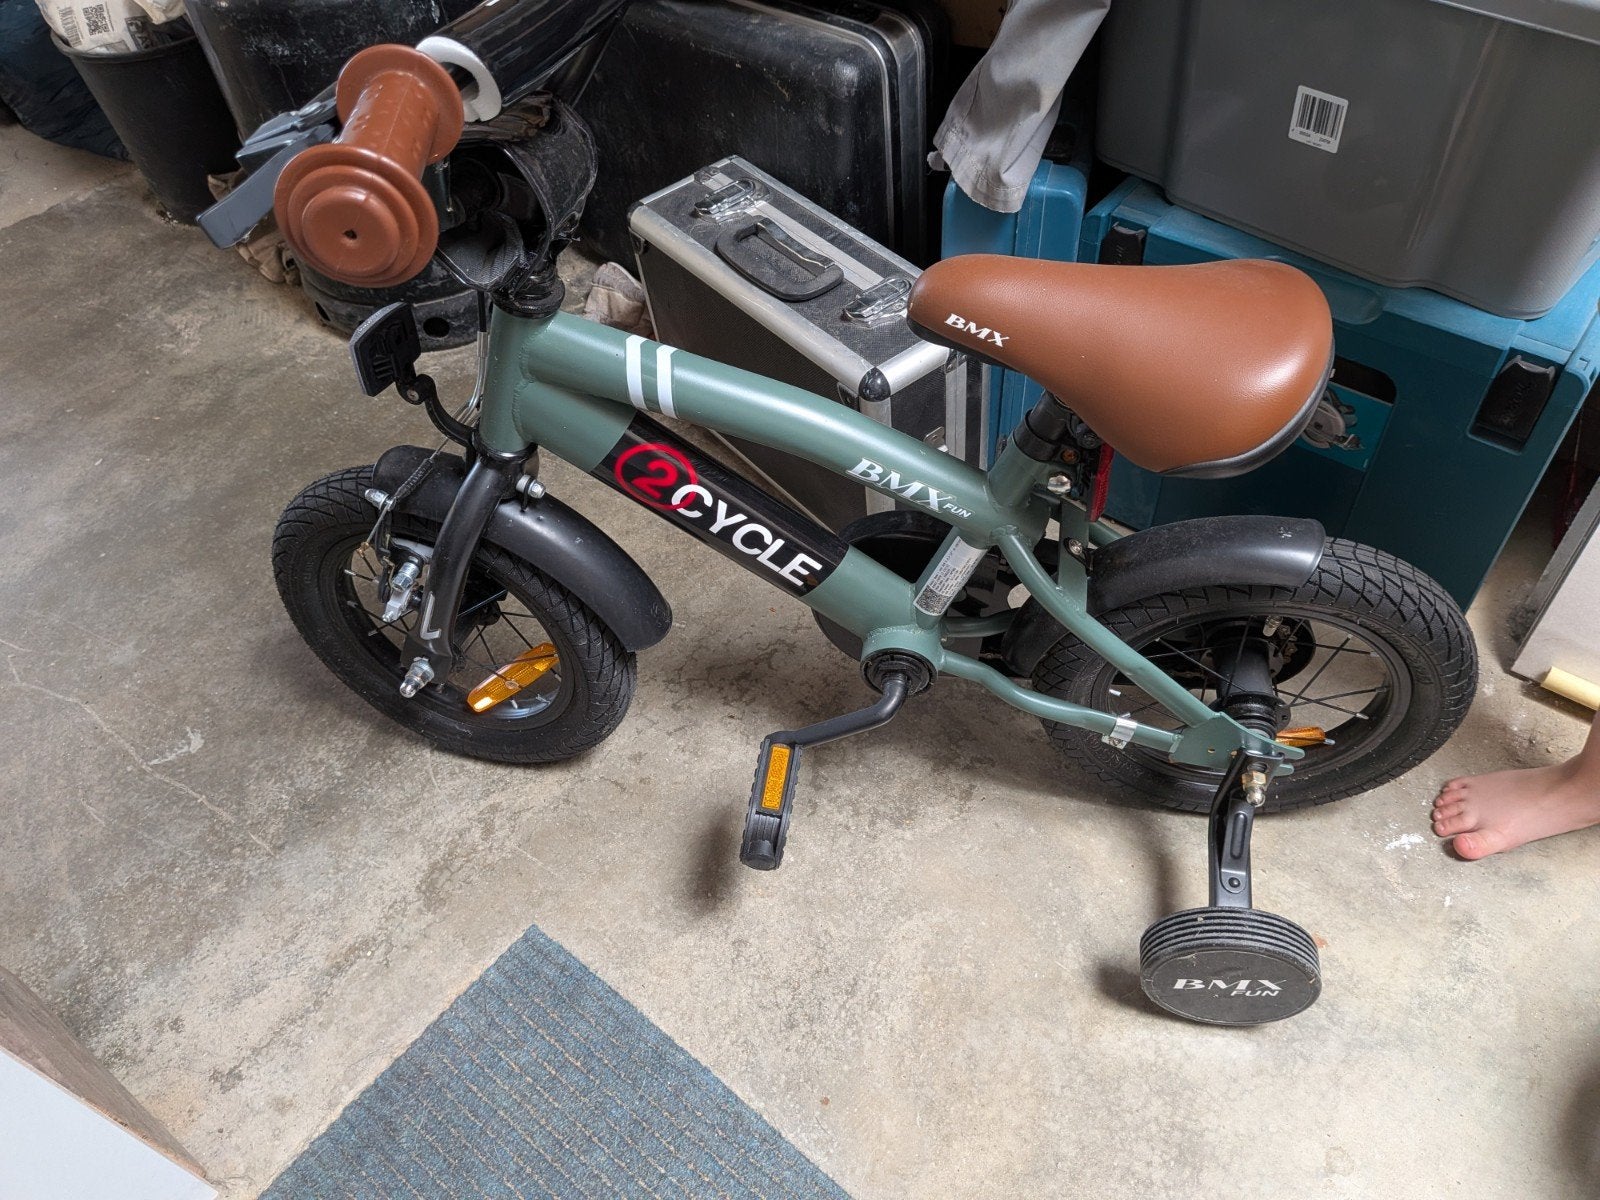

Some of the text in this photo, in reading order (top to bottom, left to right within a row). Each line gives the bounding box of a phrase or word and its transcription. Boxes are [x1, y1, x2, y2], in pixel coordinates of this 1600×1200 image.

[944, 313, 1010, 347] BMX
[846, 458, 972, 519] BMX FUN
[1173, 978, 1287, 991] BMX
